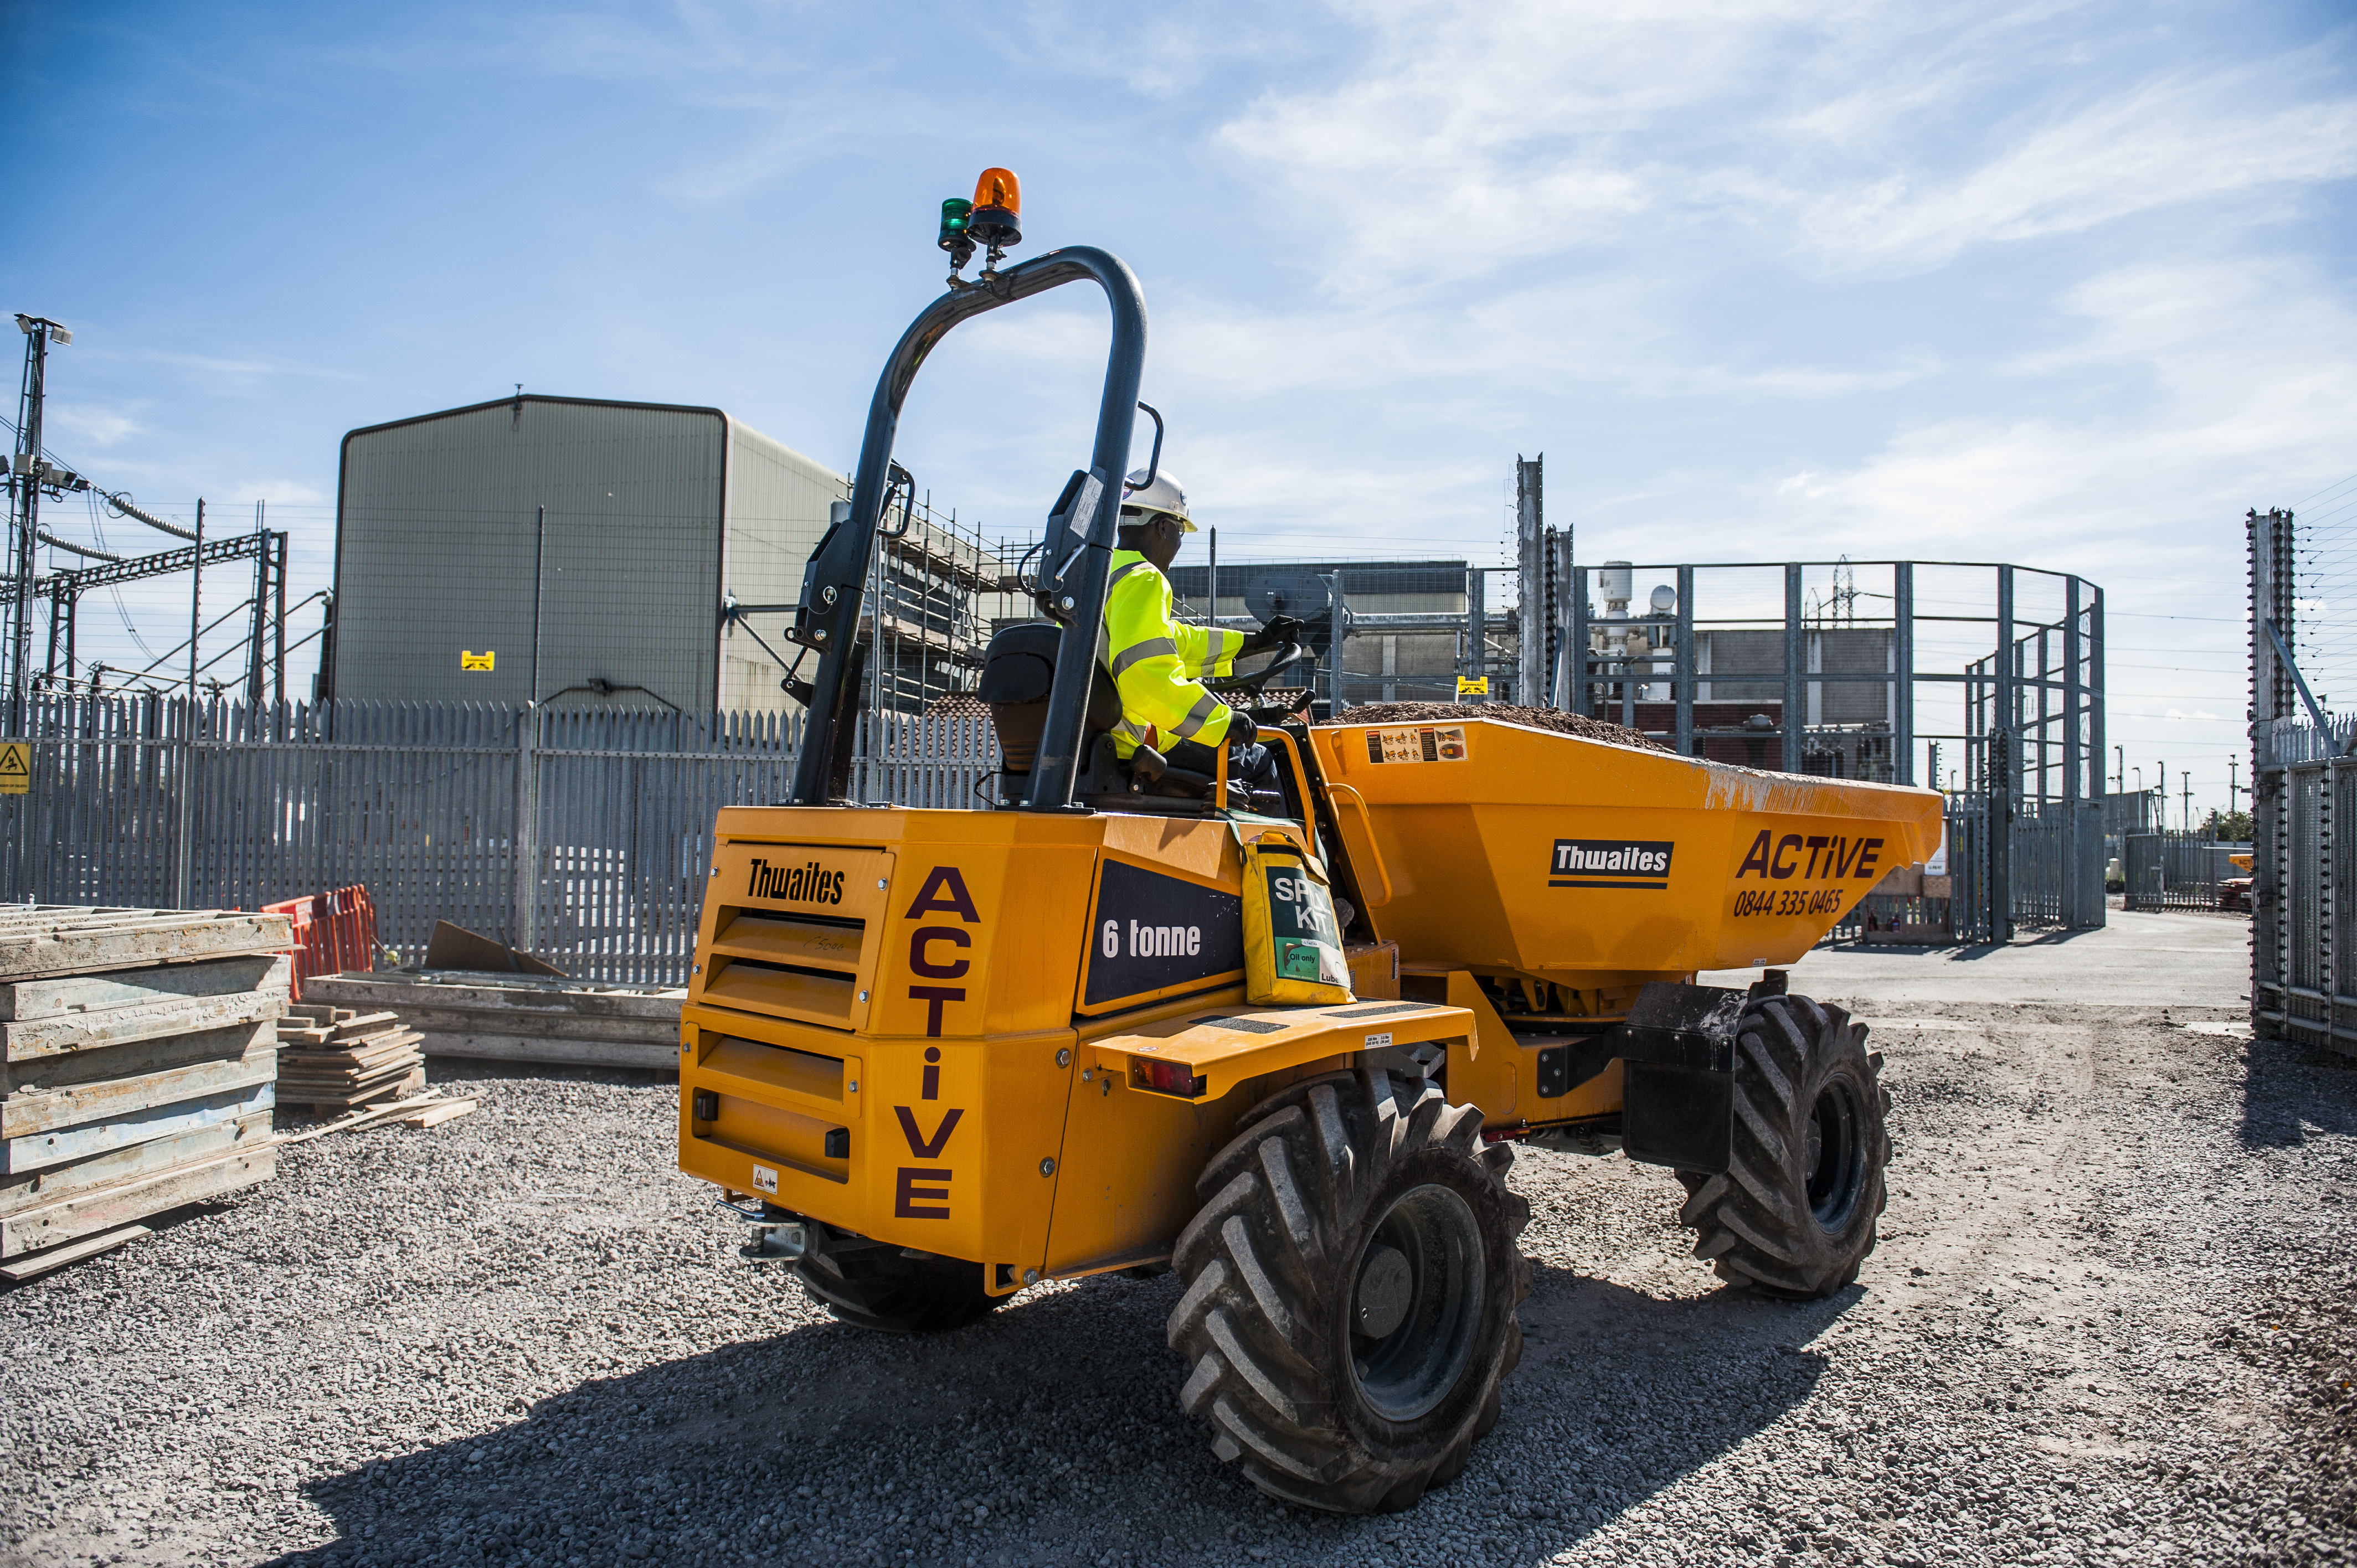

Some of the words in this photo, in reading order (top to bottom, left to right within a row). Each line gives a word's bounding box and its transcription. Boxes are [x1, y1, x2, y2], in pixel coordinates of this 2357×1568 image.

[1557, 845, 1667, 871] Thwaites
[748, 858, 845, 905] Thwaites
[1275, 878, 1332, 916] SPILL
[1733, 890, 1776, 917] 0844
[1776, 890, 1809, 916] 335
[1808, 889, 1843, 915] 0465
[1295, 905, 1327, 937] KIT
[1103, 920, 1118, 958] 6
[1130, 919, 1200, 957] tonne
[1301, 955, 1315, 963] only
